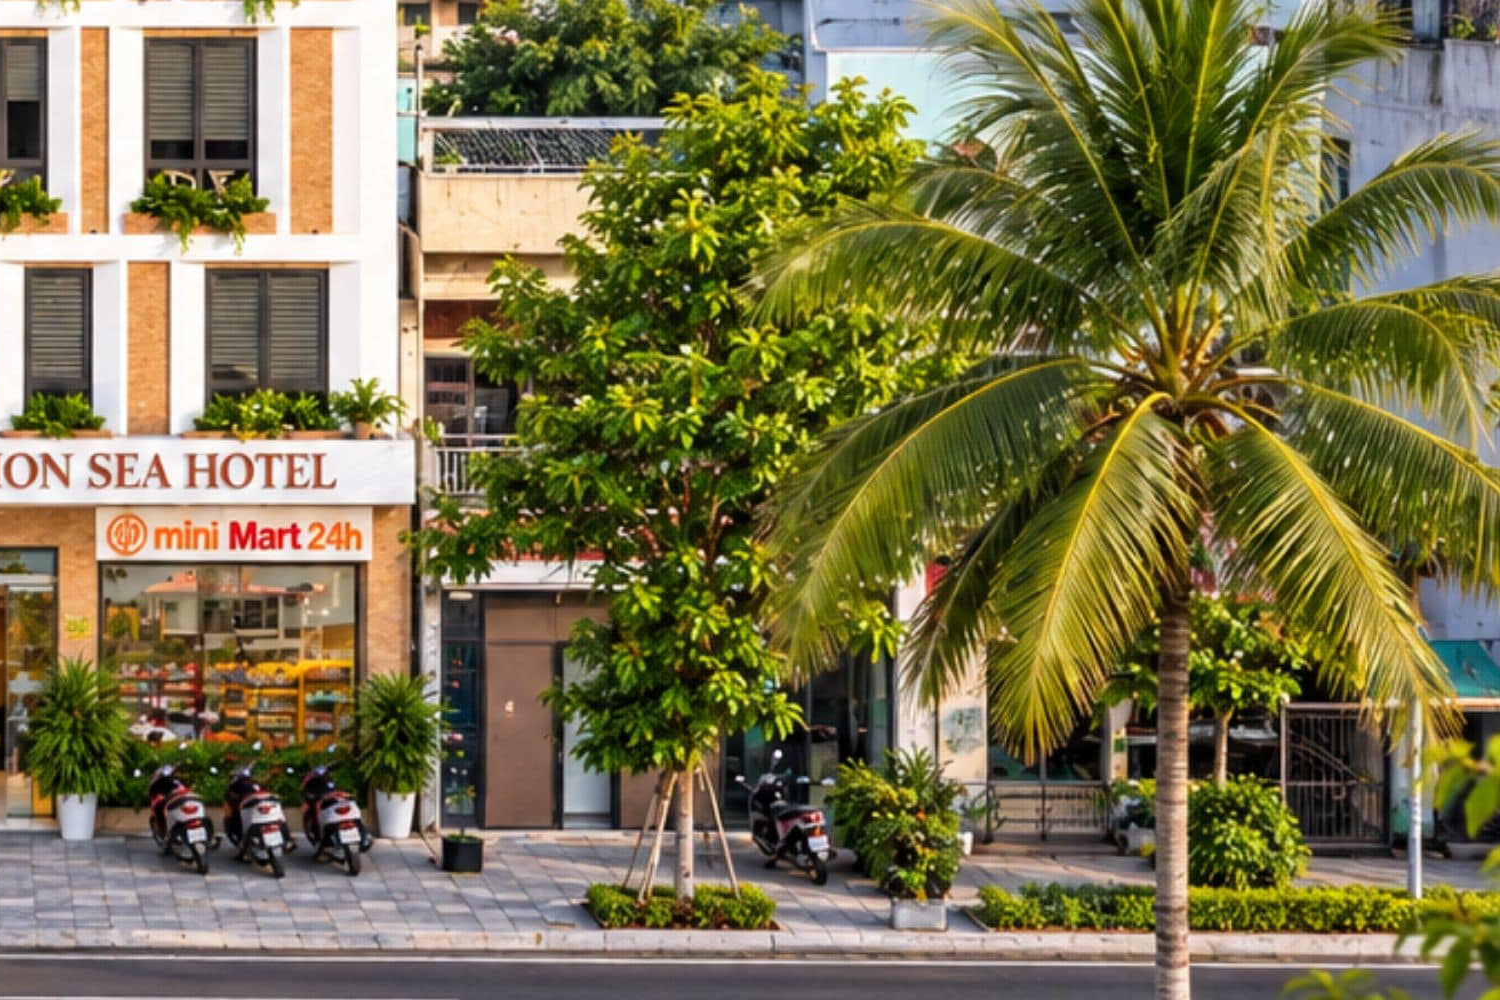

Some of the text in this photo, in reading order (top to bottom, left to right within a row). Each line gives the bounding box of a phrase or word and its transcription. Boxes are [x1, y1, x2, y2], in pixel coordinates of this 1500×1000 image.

[87, 452, 172, 488] SEA
[185, 452, 337, 489] HOTEL
[153, 520, 363, 551] mini Mart 24h
